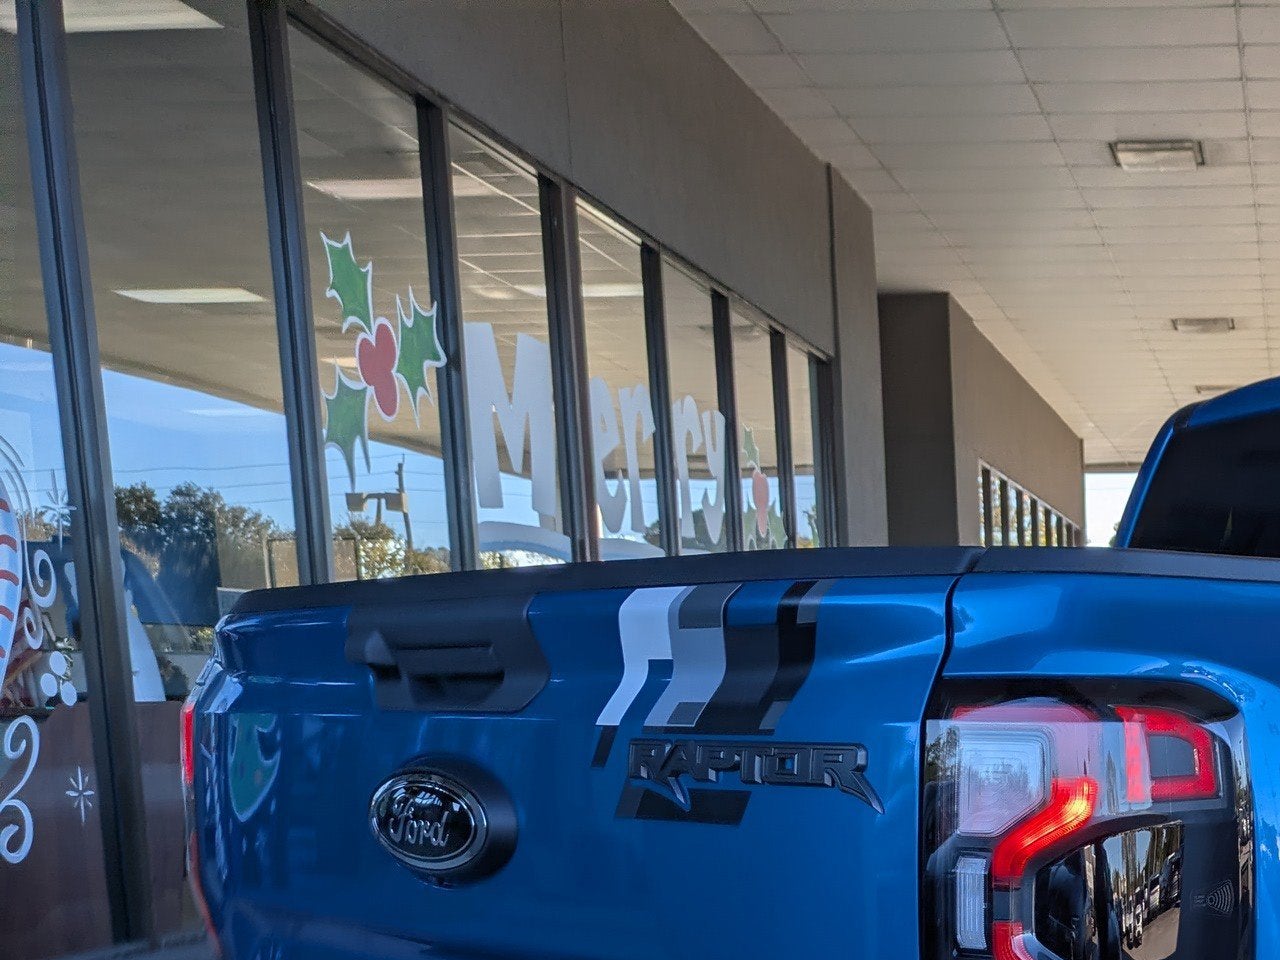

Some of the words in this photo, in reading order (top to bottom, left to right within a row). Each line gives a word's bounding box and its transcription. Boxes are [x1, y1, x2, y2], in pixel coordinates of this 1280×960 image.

[463, 321, 728, 545] Merry
[628, 737, 885, 815] RAPTOR
[389, 799, 450, 847] Ford
